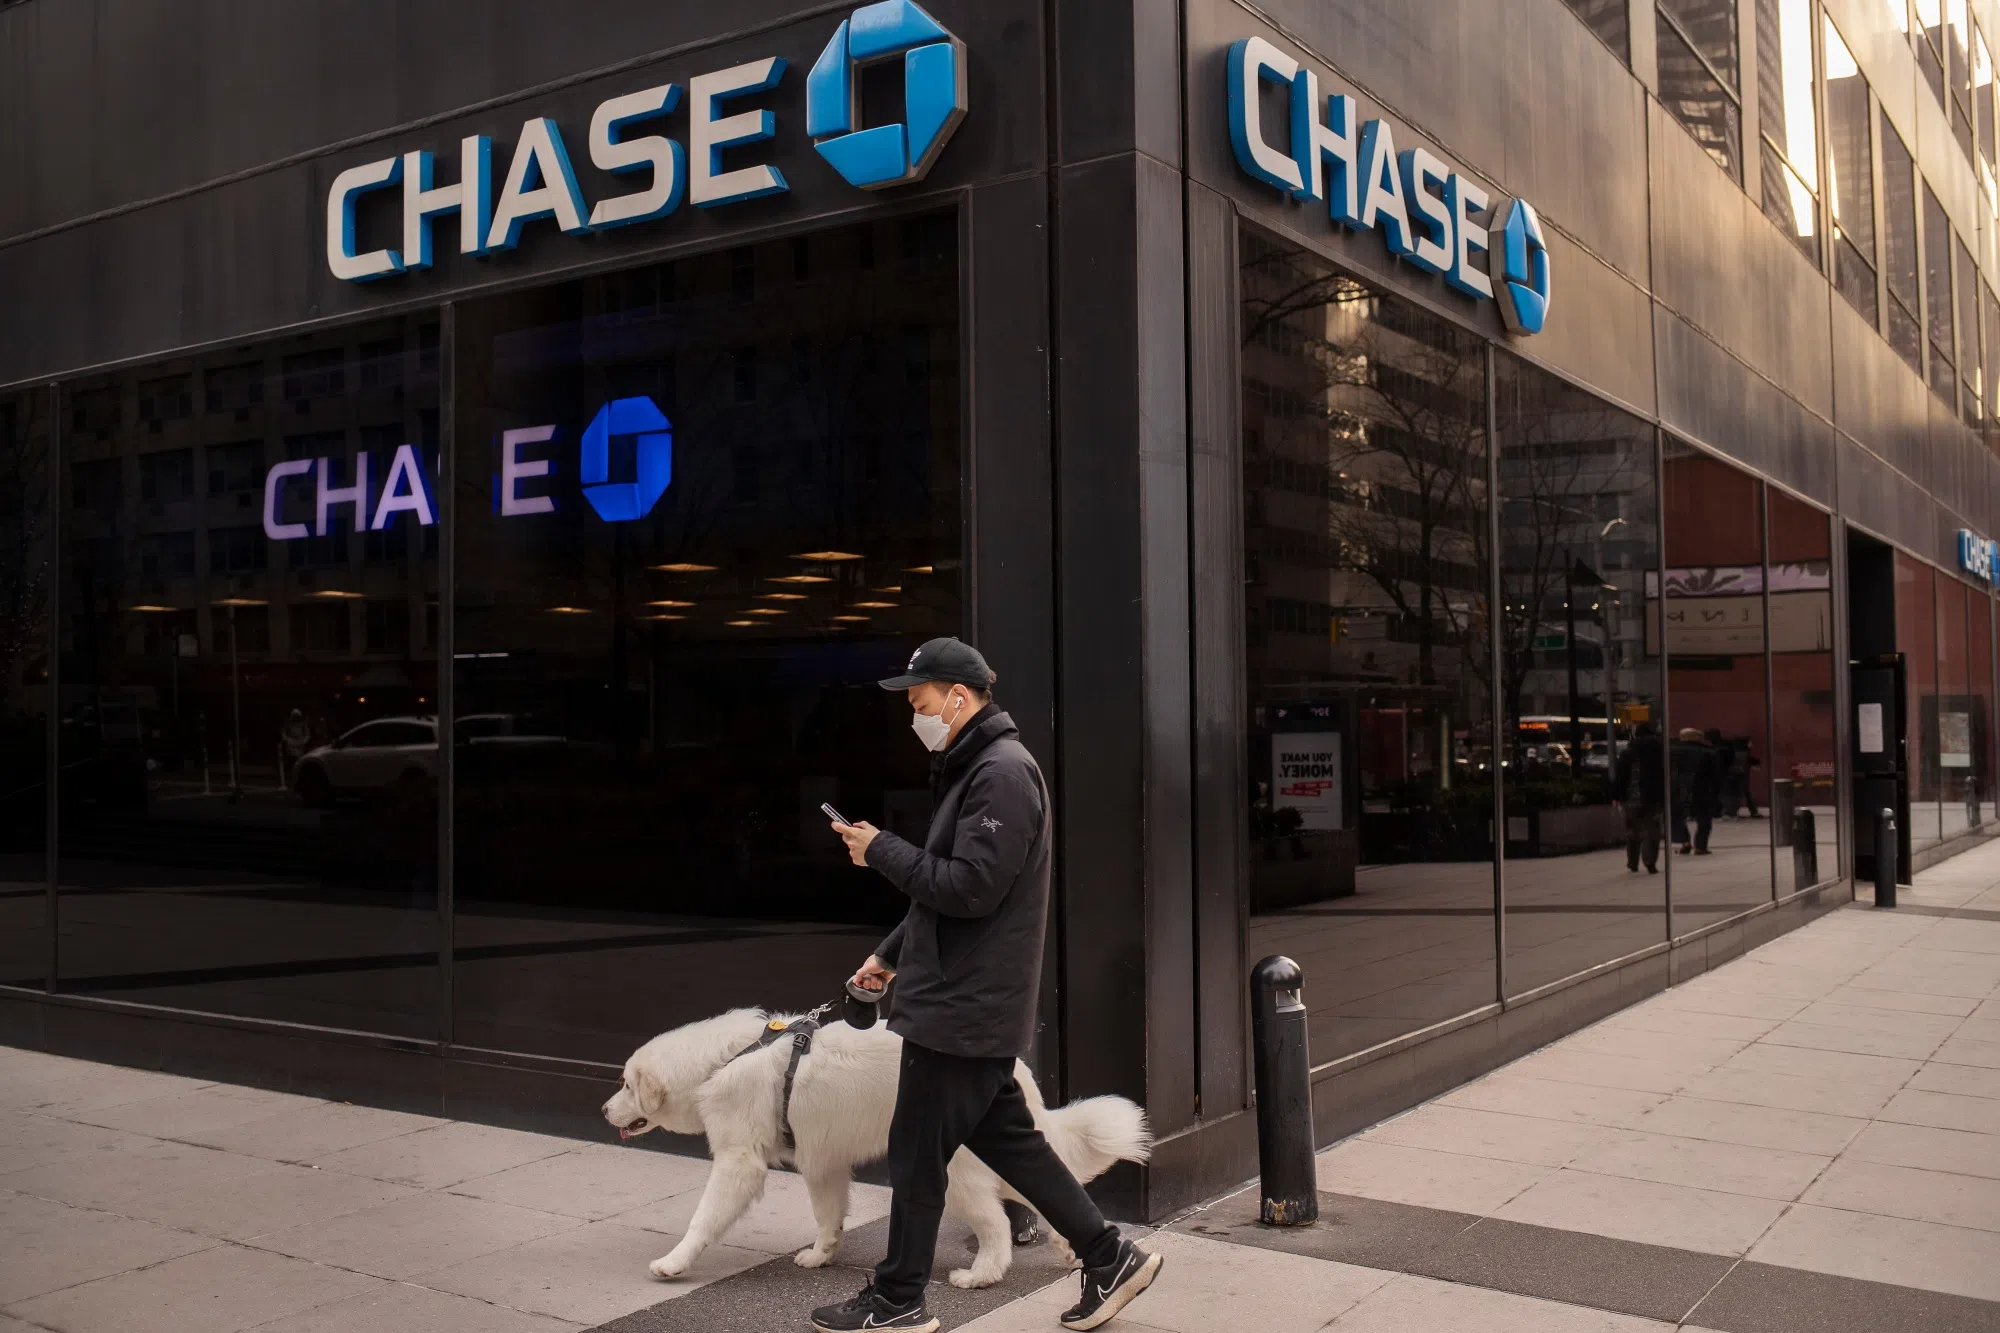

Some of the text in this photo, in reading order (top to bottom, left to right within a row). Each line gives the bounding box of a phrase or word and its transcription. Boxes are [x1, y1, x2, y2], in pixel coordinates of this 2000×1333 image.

[327, 56, 791, 282] CHASE
[1227, 36, 1494, 300] CHASE
[263, 424, 557, 540] CHAE
